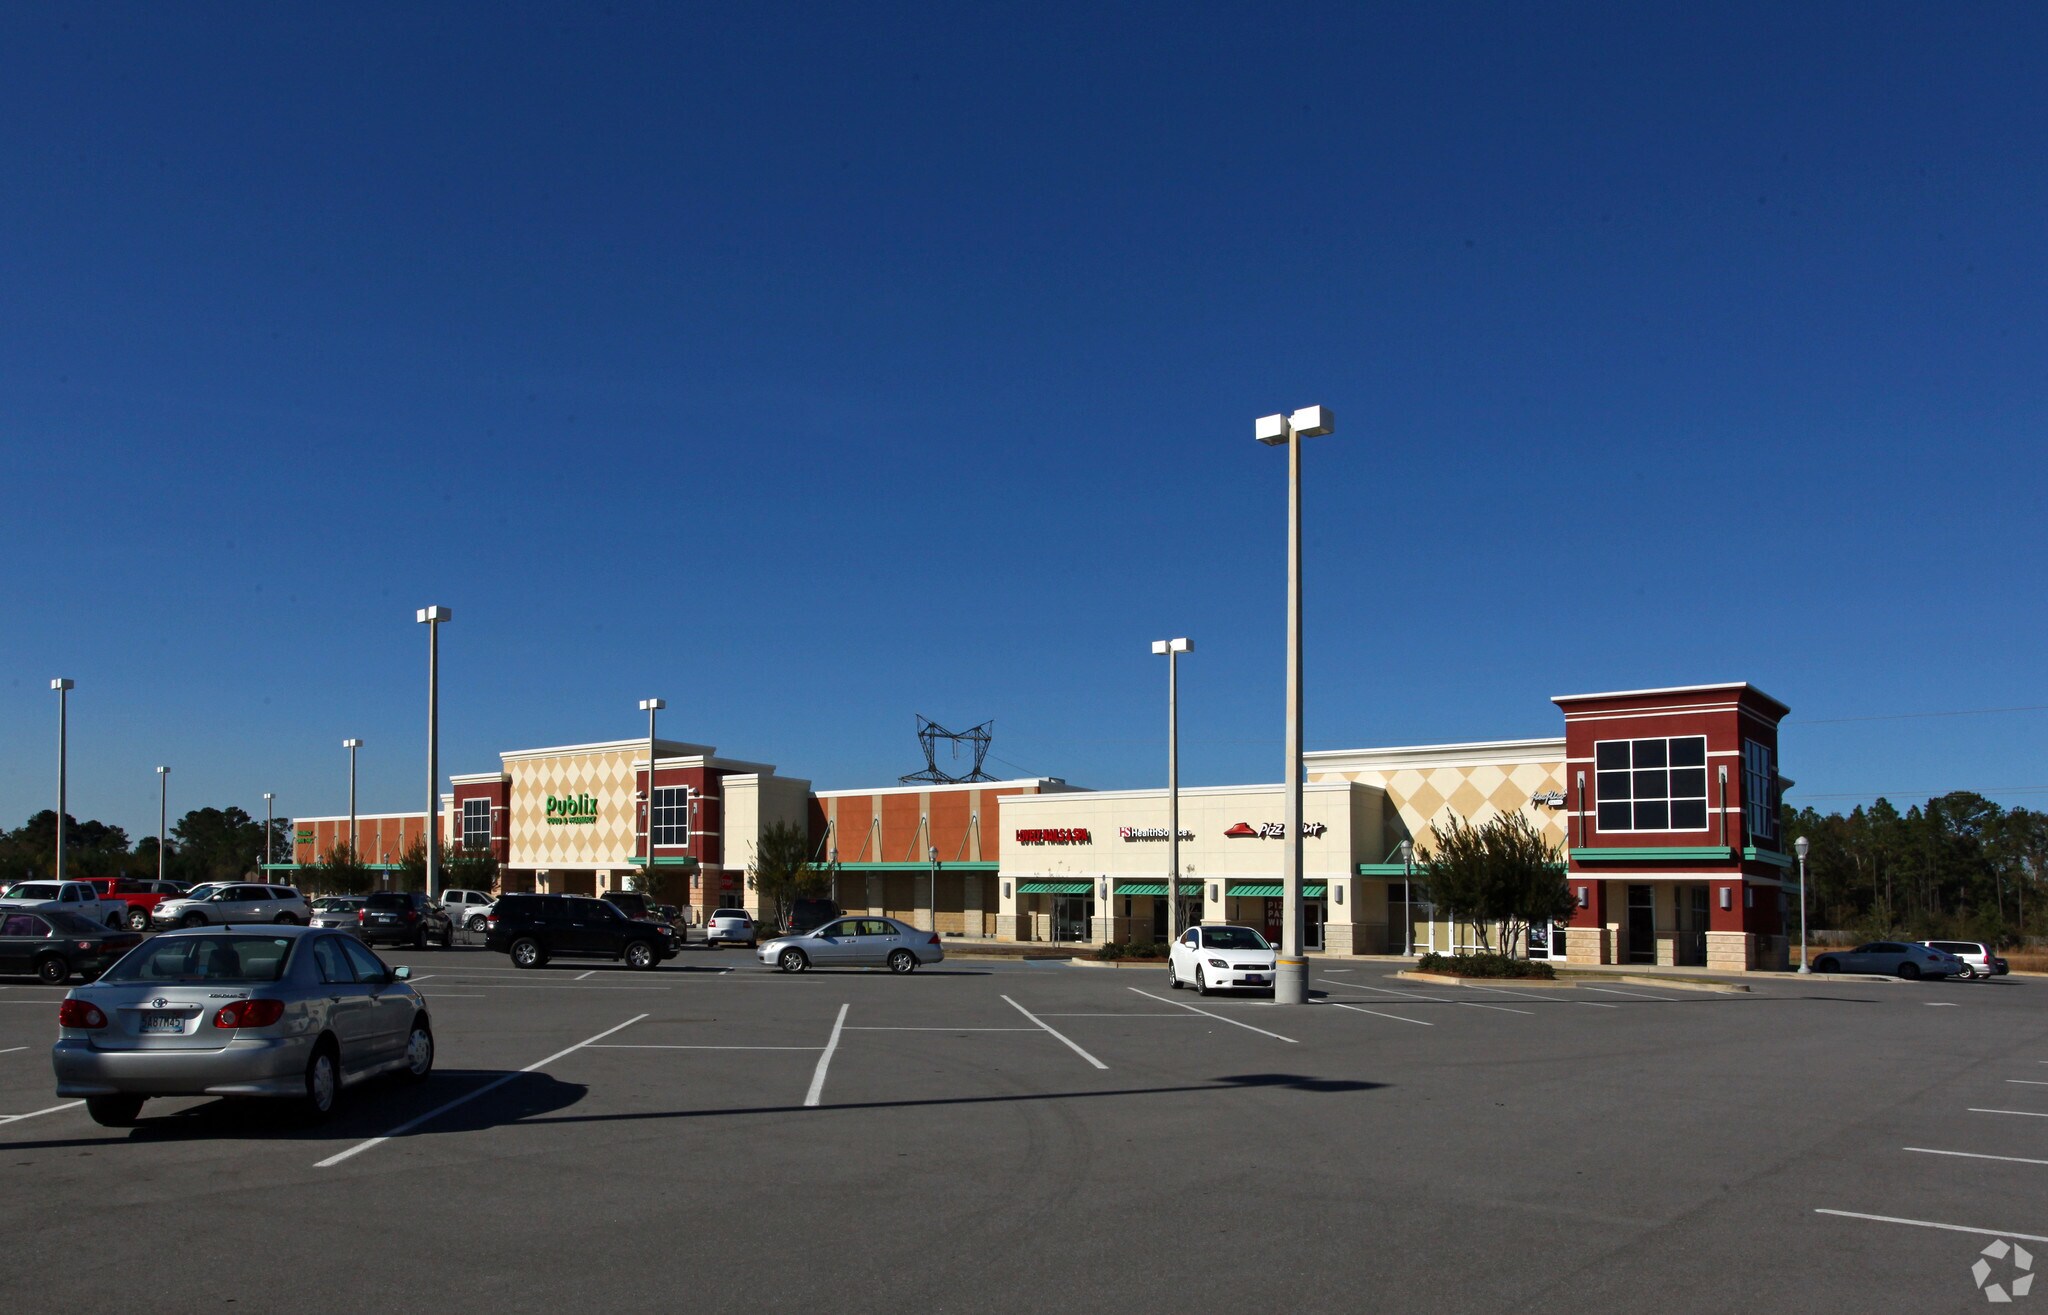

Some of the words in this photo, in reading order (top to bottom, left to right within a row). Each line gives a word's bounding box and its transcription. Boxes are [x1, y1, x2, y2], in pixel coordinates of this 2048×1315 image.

[546, 793, 598, 816] Publix
[1016, 829, 1043, 842] LOVELY
[1043, 828, 1066, 841] NAILS
[1073, 828, 1088, 841] SPA
[1119, 827, 1131, 837] HS
[1131, 828, 1188, 837] HealthSoce
[1258, 823, 1285, 837] Pizz
